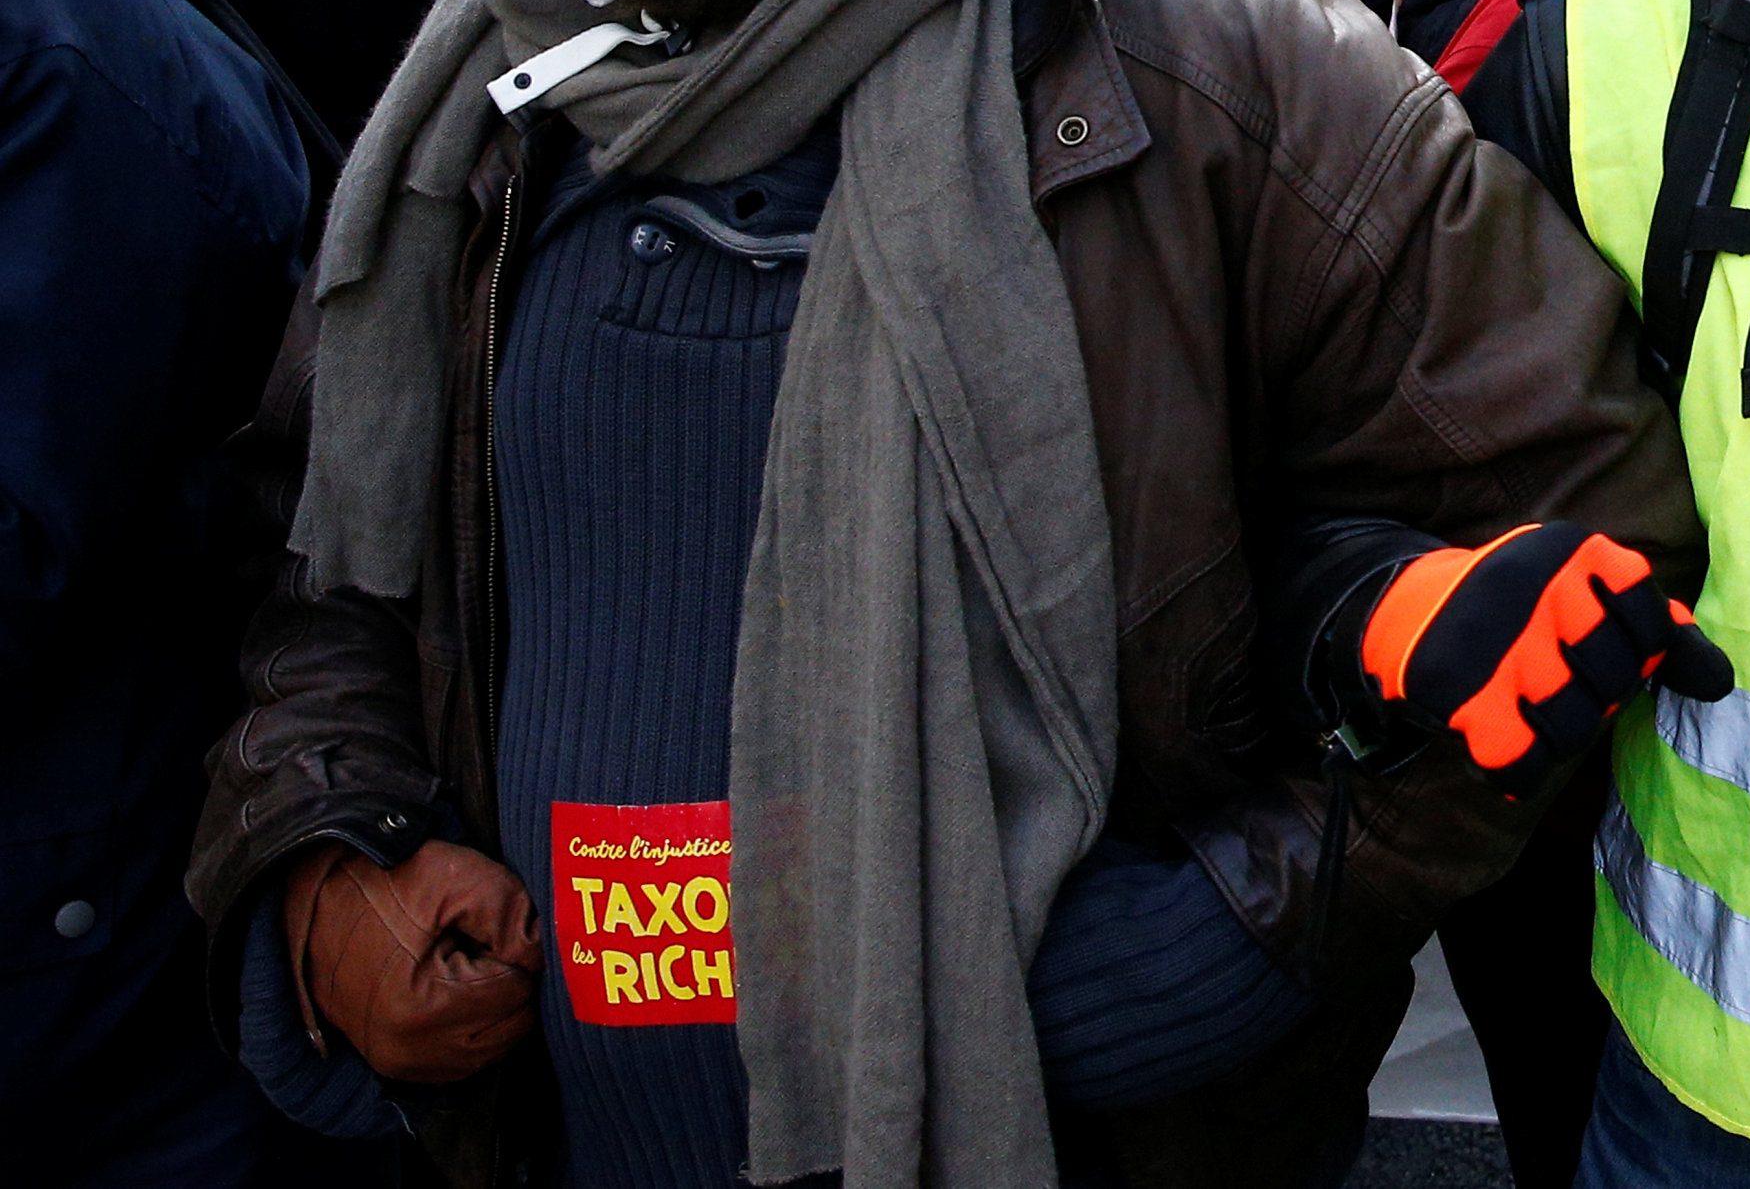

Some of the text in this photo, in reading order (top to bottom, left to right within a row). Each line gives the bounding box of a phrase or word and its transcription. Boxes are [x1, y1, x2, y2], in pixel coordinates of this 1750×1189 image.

[569, 835, 732, 866] Contre l'injustice
[571, 876, 731, 937] TAXO
[572, 941, 735, 1004] les RICH
